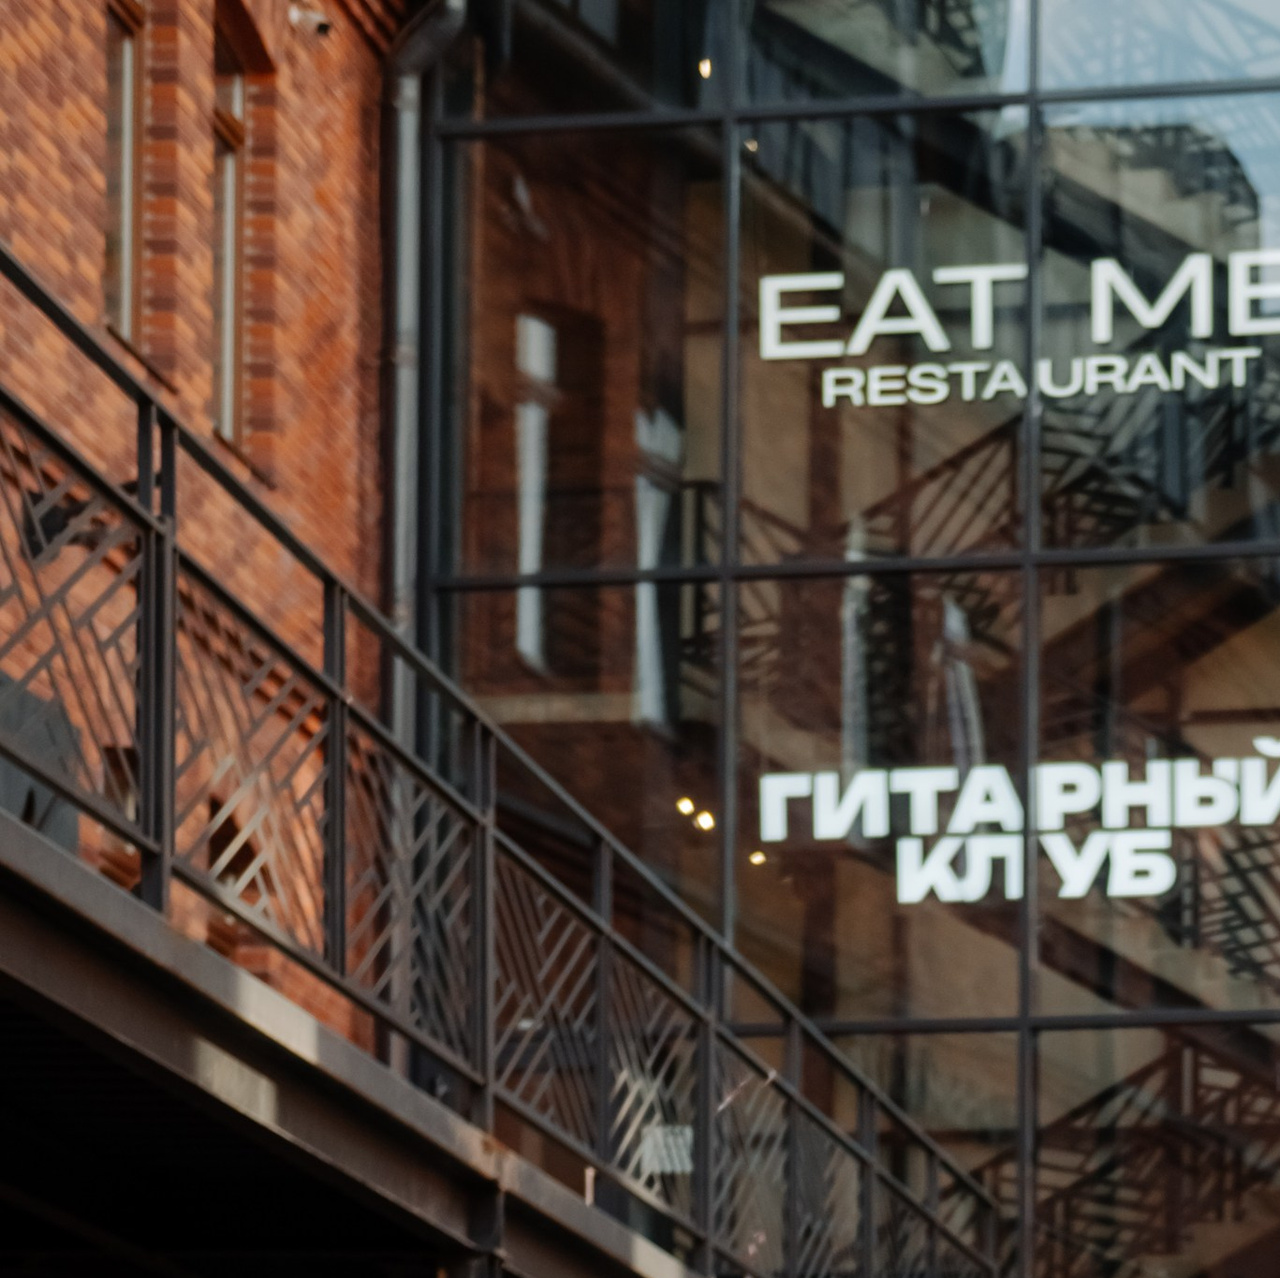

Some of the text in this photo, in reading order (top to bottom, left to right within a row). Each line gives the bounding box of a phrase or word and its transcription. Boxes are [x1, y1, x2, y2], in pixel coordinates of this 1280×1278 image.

[758, 263, 1028, 360] EAT
[821, 347, 1263, 408] RESTAURANT
[895, 829, 1178, 904] КЛУБ
